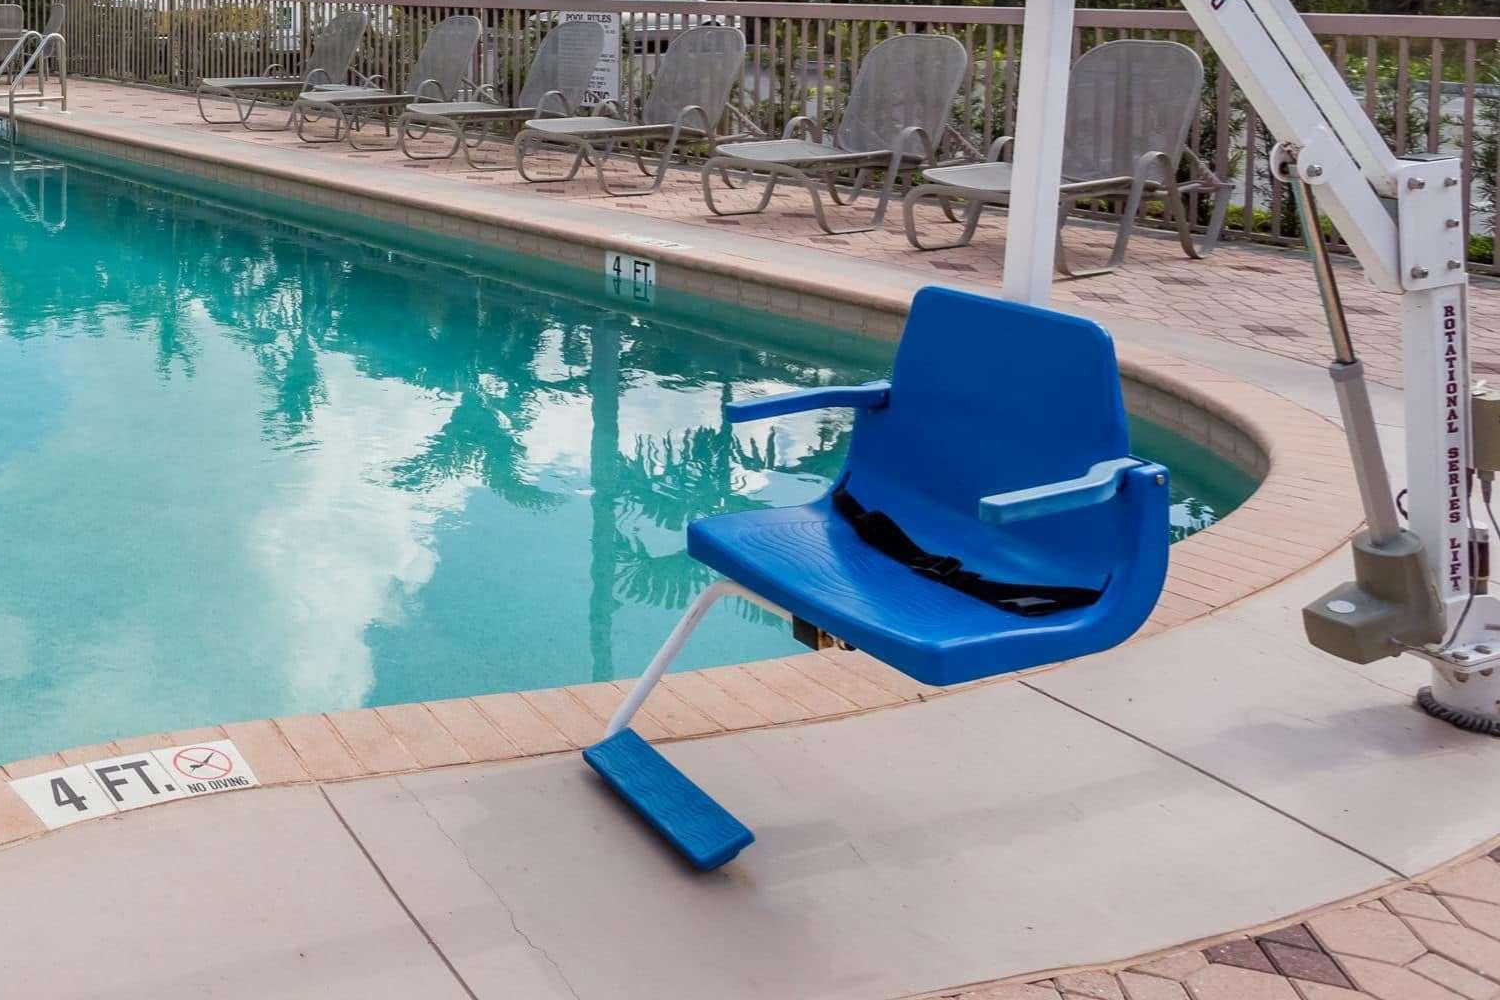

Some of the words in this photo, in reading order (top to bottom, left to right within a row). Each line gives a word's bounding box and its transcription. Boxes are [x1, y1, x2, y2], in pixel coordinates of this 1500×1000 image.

[613, 255, 622, 276] 4
[1443, 305, 1459, 433] ROTATIONAL
[1447, 447, 1461, 523] SERIES
[1449, 538, 1462, 588] LIFT
[49, 776, 88, 812] 4
[95, 759, 175, 802] FT.
[187, 781, 207, 794] NO
[210, 775, 250, 791] DIVING
